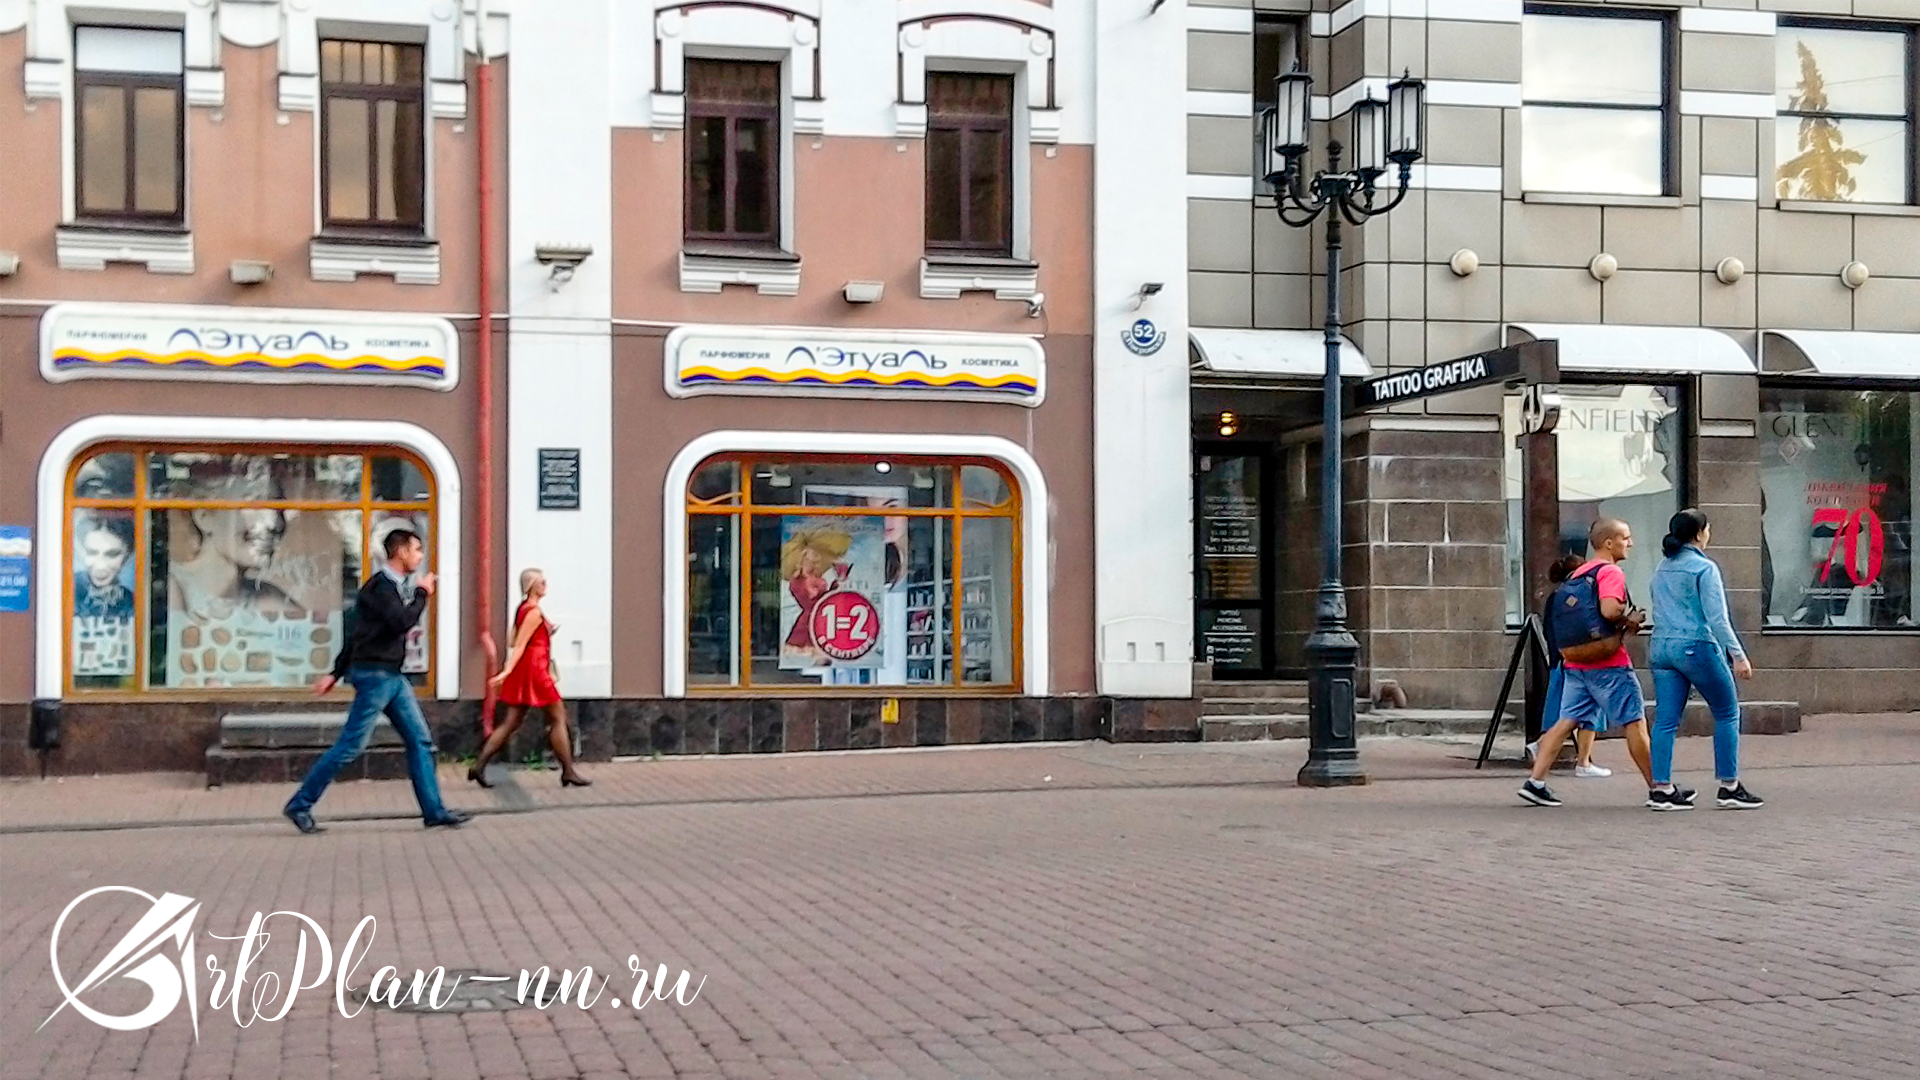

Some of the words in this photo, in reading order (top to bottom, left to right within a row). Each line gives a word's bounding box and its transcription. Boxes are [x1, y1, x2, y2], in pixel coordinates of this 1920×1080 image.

[1134, 324, 1154, 338] 52
[700, 349, 771, 359] ПАРФЮМЕРИЯ
[961, 358, 1019, 367] КОСМЕТИКА
[1372, 371, 1422, 400] TATTOO
[1423, 356, 1487, 389] GRAFIKA
[1811, 506, 1885, 587] 70
[821, 604, 870, 640] 1=2
